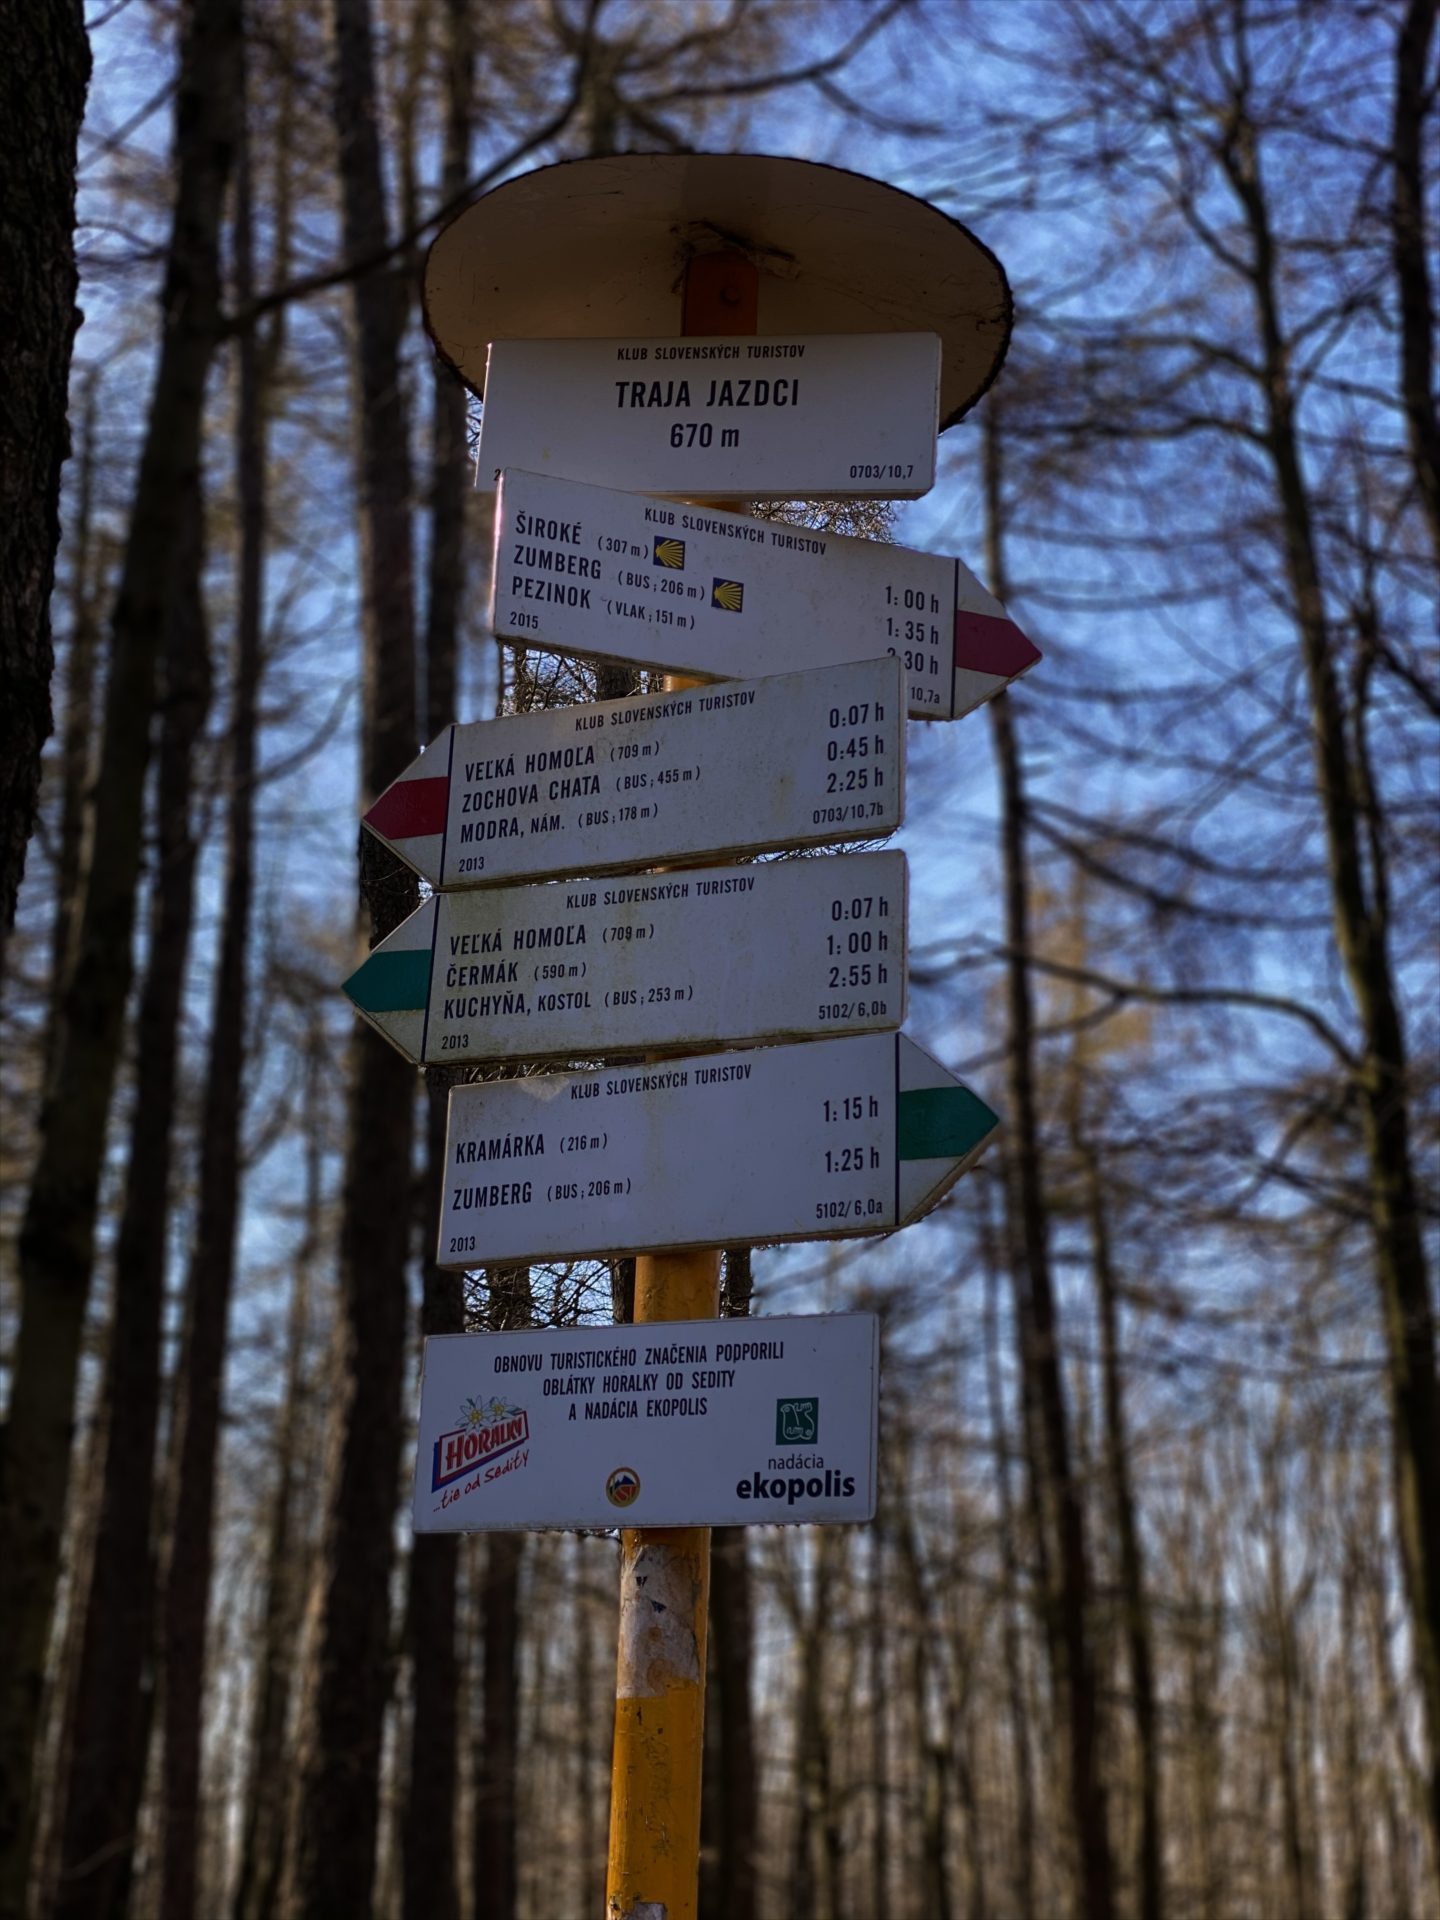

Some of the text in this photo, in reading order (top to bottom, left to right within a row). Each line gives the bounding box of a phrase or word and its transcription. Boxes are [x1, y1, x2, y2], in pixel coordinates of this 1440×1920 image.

[617, 343, 805, 361] KLUB SLOVENSKÝCH TURISTOV
[615, 377, 799, 409] TRAJA JAZDCI
[670, 422, 740, 448] 670 m
[515, 510, 582, 545] ŠIROKÉ
[598, 536, 627, 555] (307
[644, 508, 827, 555] KLUB SLOVENSKÝCH TURISTOV
[513, 544, 602, 580] ZUMBERG
[660, 579, 684, 597] 206
[511, 576, 591, 610] PEZINOK
[655, 609, 674, 627] 151
[885, 585, 939, 614] 1:00 h
[510, 611, 539, 630] 2015
[886, 617, 939, 645] 1:35 h
[929, 656, 939, 675] h
[911, 686, 940, 705] 10,7a
[575, 690, 756, 732] KLUB SLOVENSKÝCH TURISTOV
[829, 702, 884, 728] 0:07 h
[827, 734, 884, 761] 0:45 h
[465, 753, 514, 783] VEĽKÁ
[525, 745, 595, 774] HOMOĽA
[610, 744, 639, 762] (709
[462, 784, 538, 813] ZOCHOVA
[549, 775, 600, 801] CHATA
[657, 768, 680, 785] 455
[826, 766, 884, 793] 2:25 h
[460, 818, 524, 844] MODRA,
[530, 813, 565, 835] NÁM.
[618, 806, 637, 822] 178
[458, 856, 485, 873] 2013
[566, 876, 755, 909] KLUB SLOVENSKÝCH TURISTOV
[831, 896, 888, 921] 0:07 h
[449, 927, 502, 956] VEĽKÁ
[513, 924, 586, 951] HOMOĽA
[602, 927, 633, 944] (709
[827, 931, 888, 955] 1:00 h
[446, 961, 518, 988] ČERMÁK
[534, 963, 565, 982] (590
[829, 964, 888, 988] 2:55 h
[443, 989, 531, 1020] KUCHYŇA,
[537, 991, 592, 1012] KOSTOL
[648, 987, 671, 1003] 253
[441, 1034, 469, 1050] 2013
[571, 1064, 752, 1100] KLUB SLOVENSKÝCH TURISTOV
[824, 1095, 879, 1122] 1:15 h
[455, 1133, 545, 1164] KRAMÁRKA
[560, 1135, 588, 1154] (216
[825, 1146, 880, 1173] 1:25 h
[452, 1181, 532, 1211] ZUMBERG
[588, 1180, 610, 1196] 206
[450, 1236, 476, 1253] 2013
[494, 1341, 785, 1374] OBNOVU TURISTICKÉHO ZNAČENIA PODPORILI
[542, 1370, 735, 1396] OBLÁTKY HORALKY OD SEDITY
[567, 1395, 708, 1421] A NADÁCIA EKOPOLIS
[446, 1417, 523, 1471] HORALKY
[767, 1453, 824, 1470] nadácia
[735, 1469, 856, 1505] ekopolis
